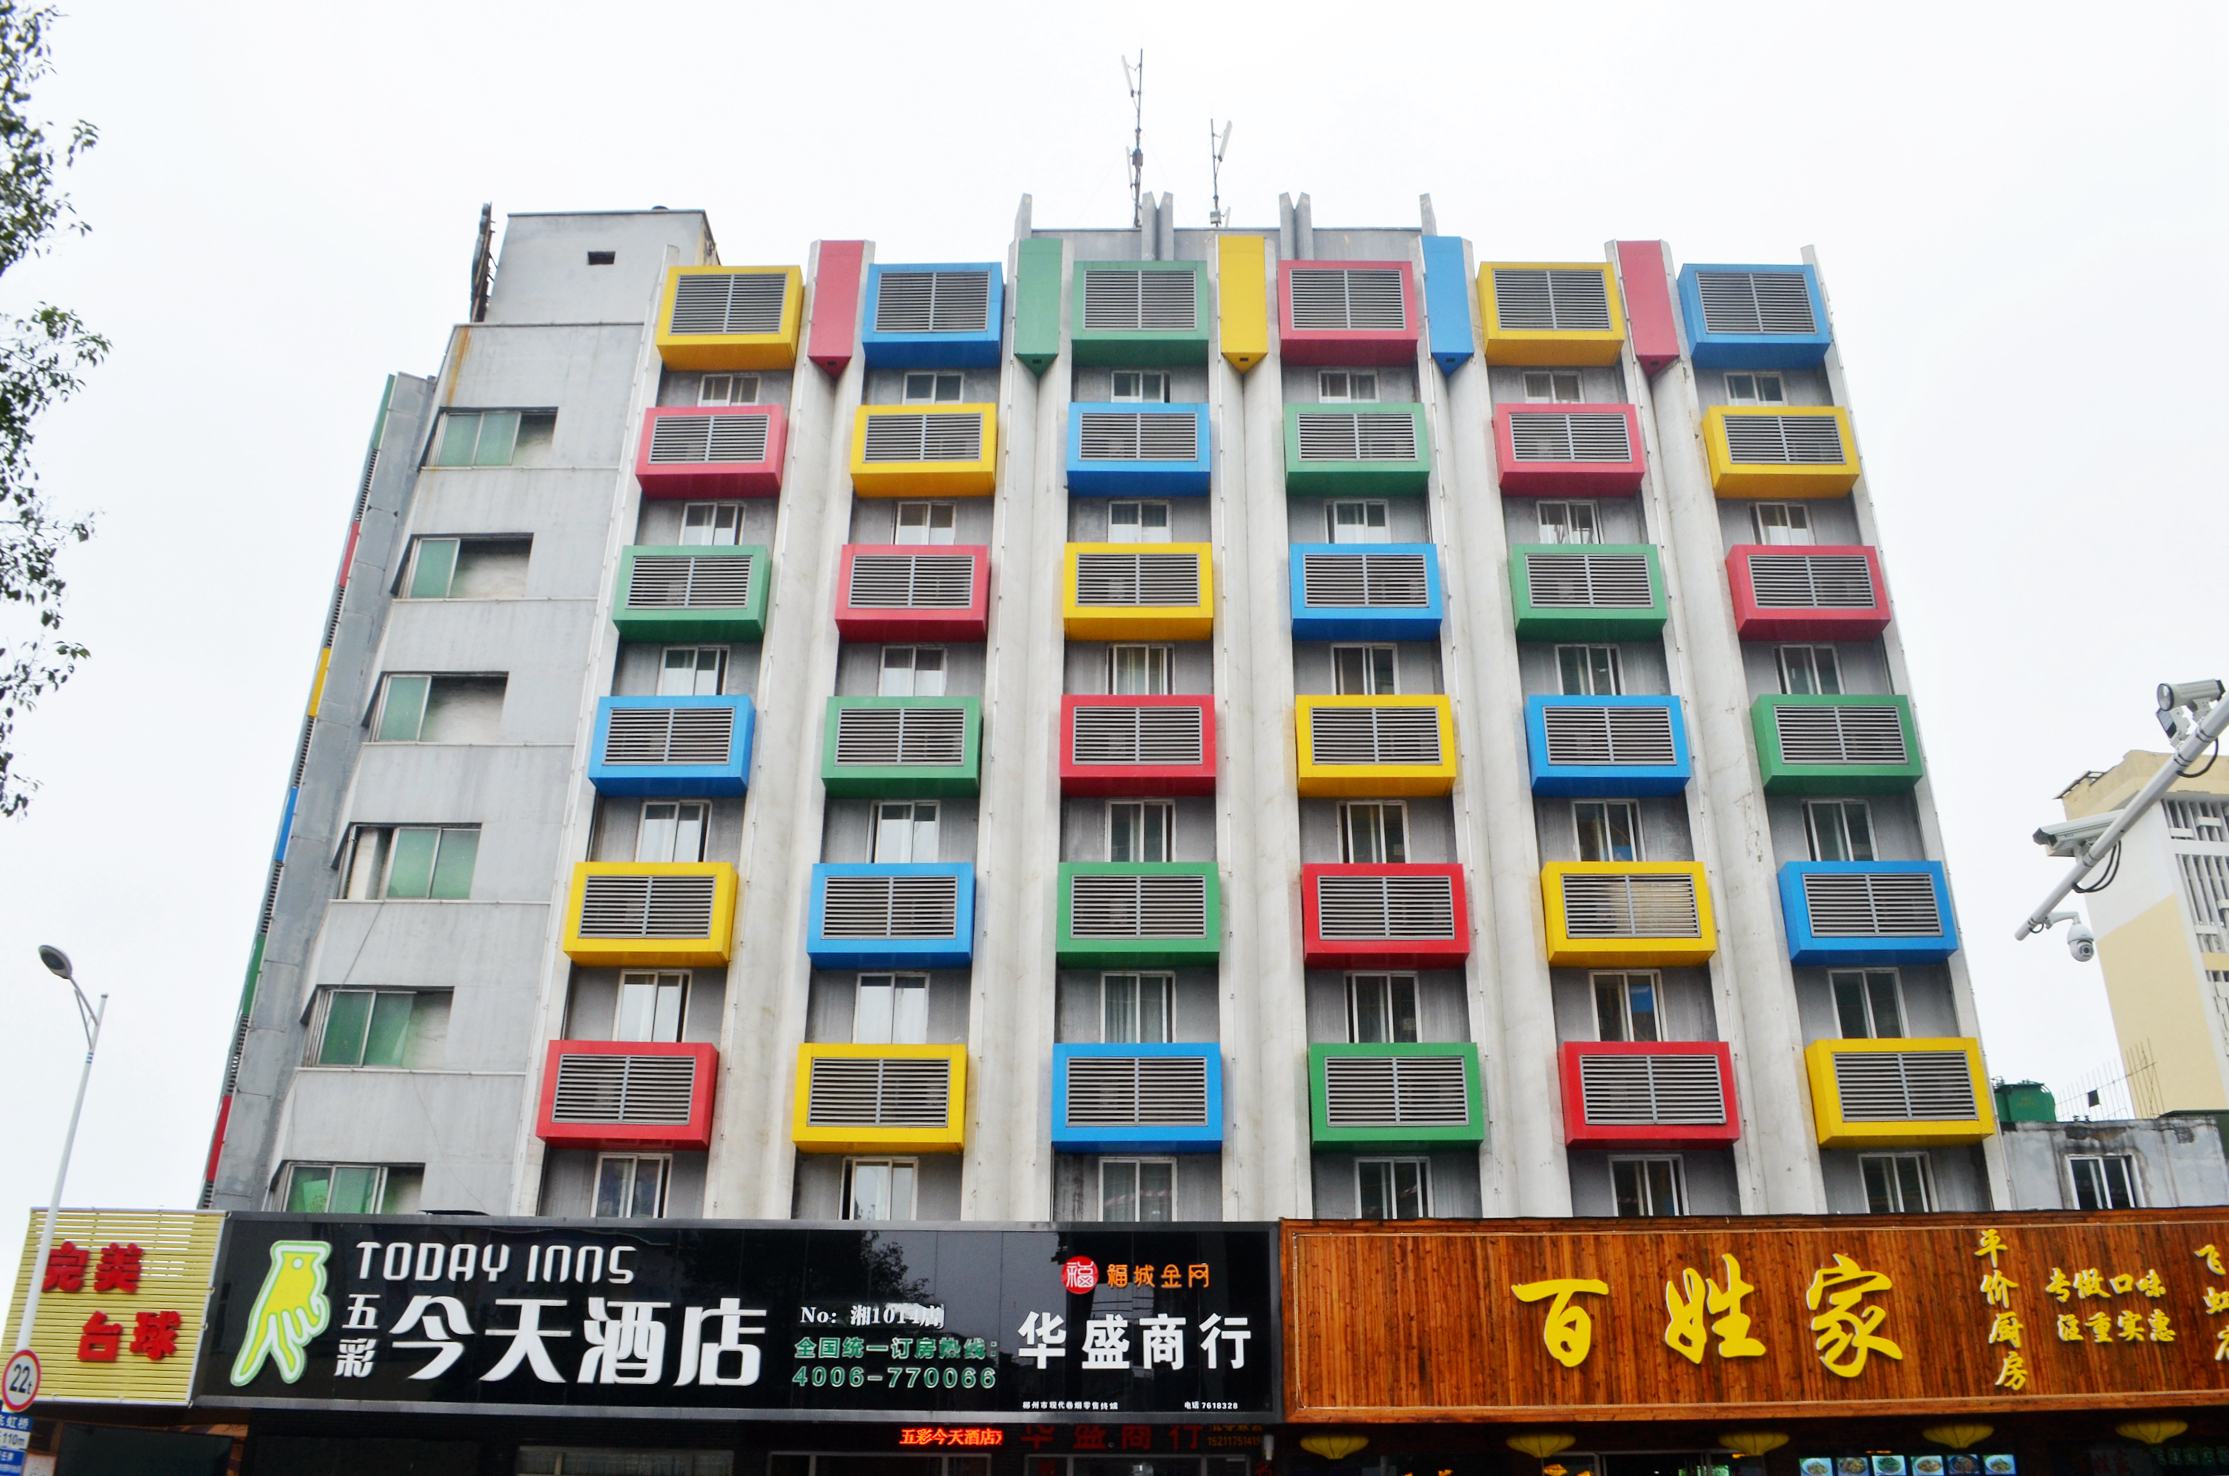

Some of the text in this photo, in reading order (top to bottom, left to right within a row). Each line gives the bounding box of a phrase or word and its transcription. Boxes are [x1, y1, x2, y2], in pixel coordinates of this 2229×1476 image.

[42, 1241, 144, 1293] 完美
[356, 1241, 509, 1282] TODAY
[1107, 1263, 1210, 1289] 福城金网
[2045, 1267, 2166, 1303] 专做口味
[334, 1293, 381, 1378] 五彩
[1511, 1253, 1903, 1378] 百姓家
[1975, 1228, 2028, 1391] 平价厨房
[2057, 1308, 2176, 1343] 注重实惠
[77, 1310, 181, 1362] 台球
[389, 1295, 767, 1386] 今天酒店
[1018, 1311, 1252, 1370] 华盛商行
[792, 1366, 996, 1388] 4006-770066
[1184, 1401, 1199, 1409] 电话
